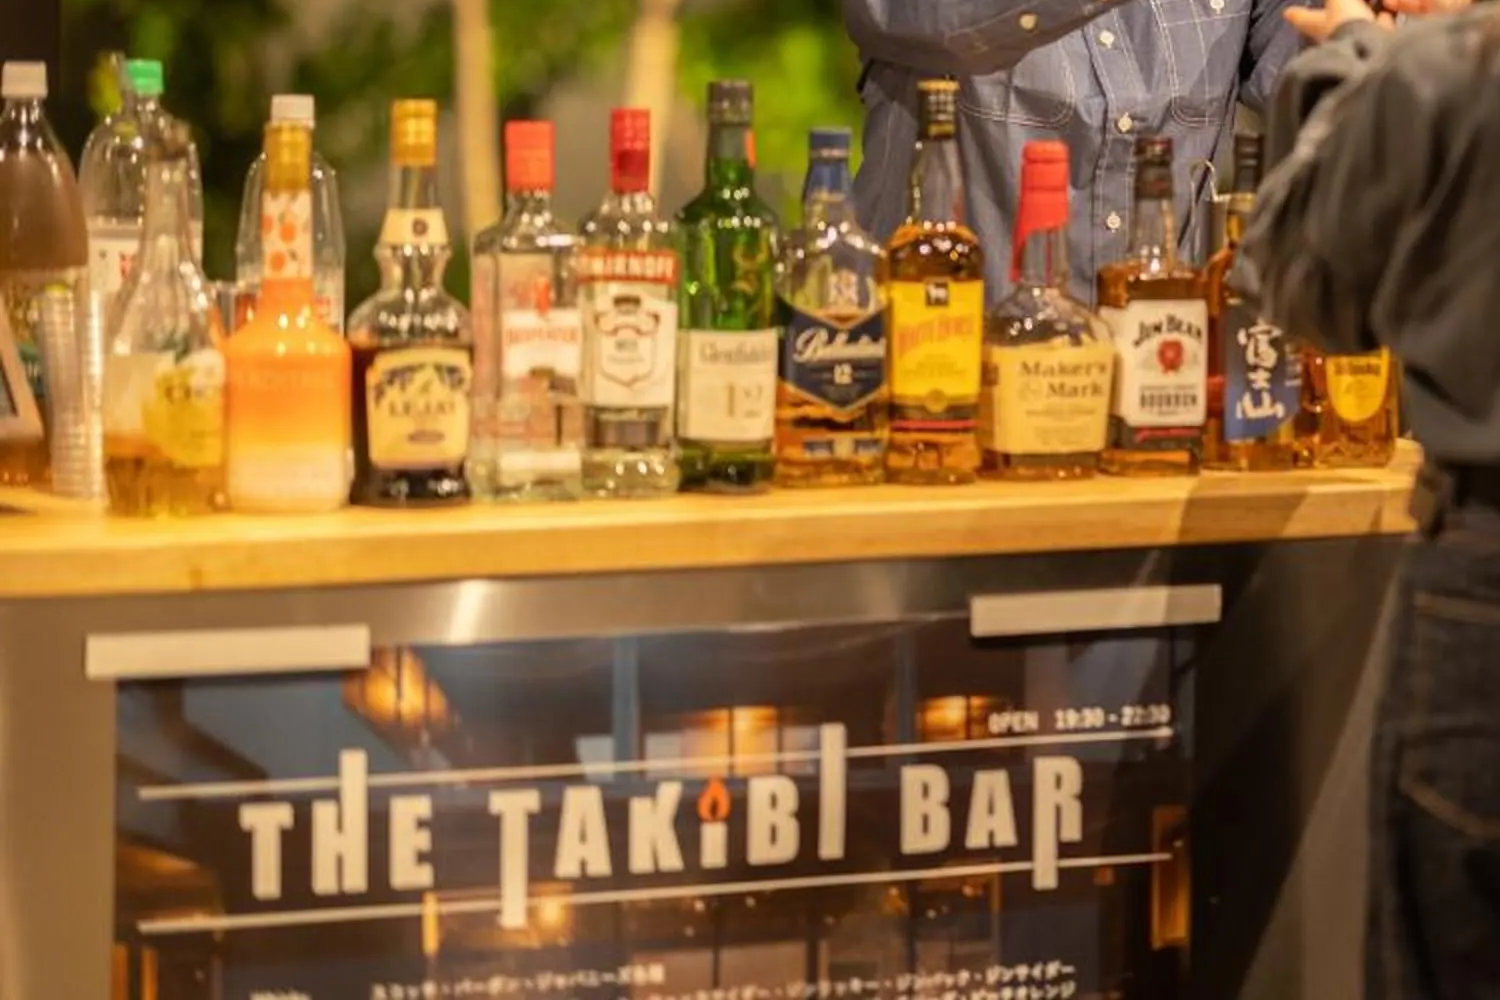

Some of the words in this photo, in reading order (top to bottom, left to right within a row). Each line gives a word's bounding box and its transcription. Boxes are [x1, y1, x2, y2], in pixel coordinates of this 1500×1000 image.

[988, 711, 1039, 734] OPEN
[239, 749, 433, 898] THE
[900, 756, 1083, 891] BAR
